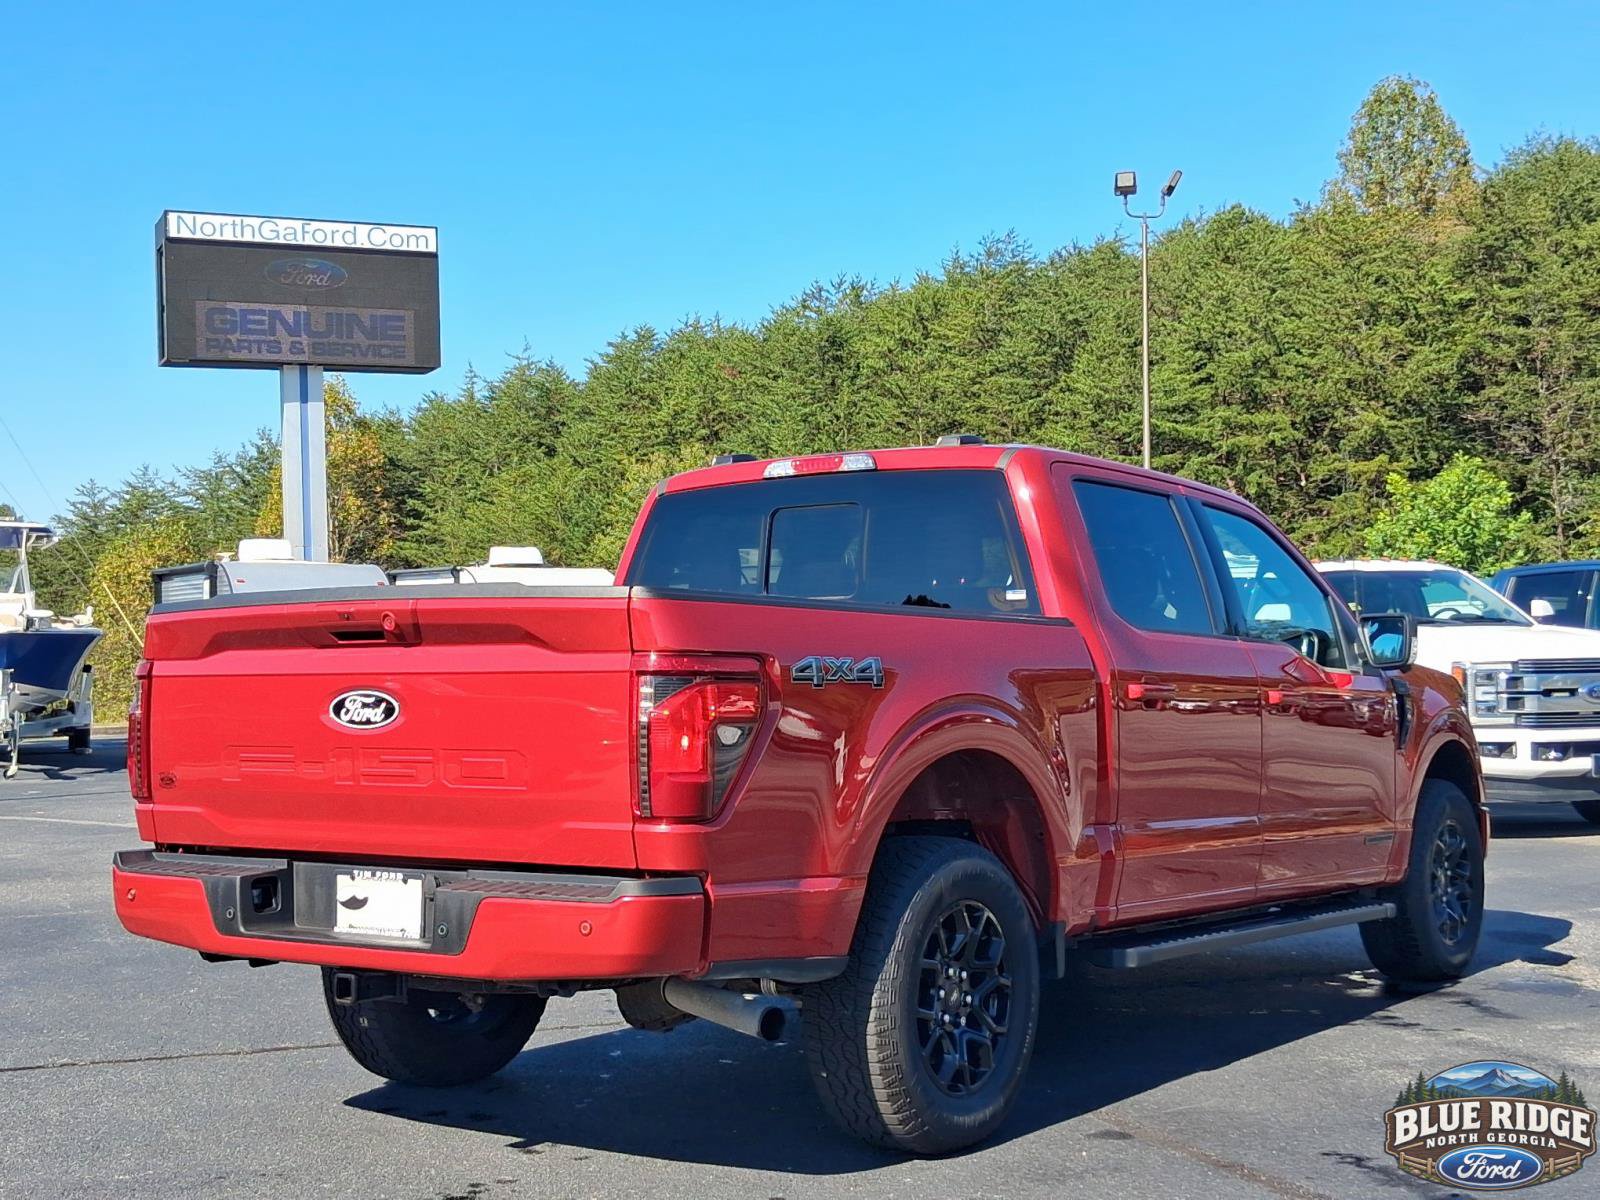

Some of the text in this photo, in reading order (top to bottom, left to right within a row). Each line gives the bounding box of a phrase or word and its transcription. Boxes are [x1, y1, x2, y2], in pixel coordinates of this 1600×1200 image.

[176, 214, 429, 249] NorthGaFord.Com
[280, 263, 332, 286] Ford
[205, 307, 406, 341] GENUINE
[206, 337, 406, 360] PARTS & SERVICE
[340, 695, 387, 723] Ford
[221, 745, 528, 790] F-150
